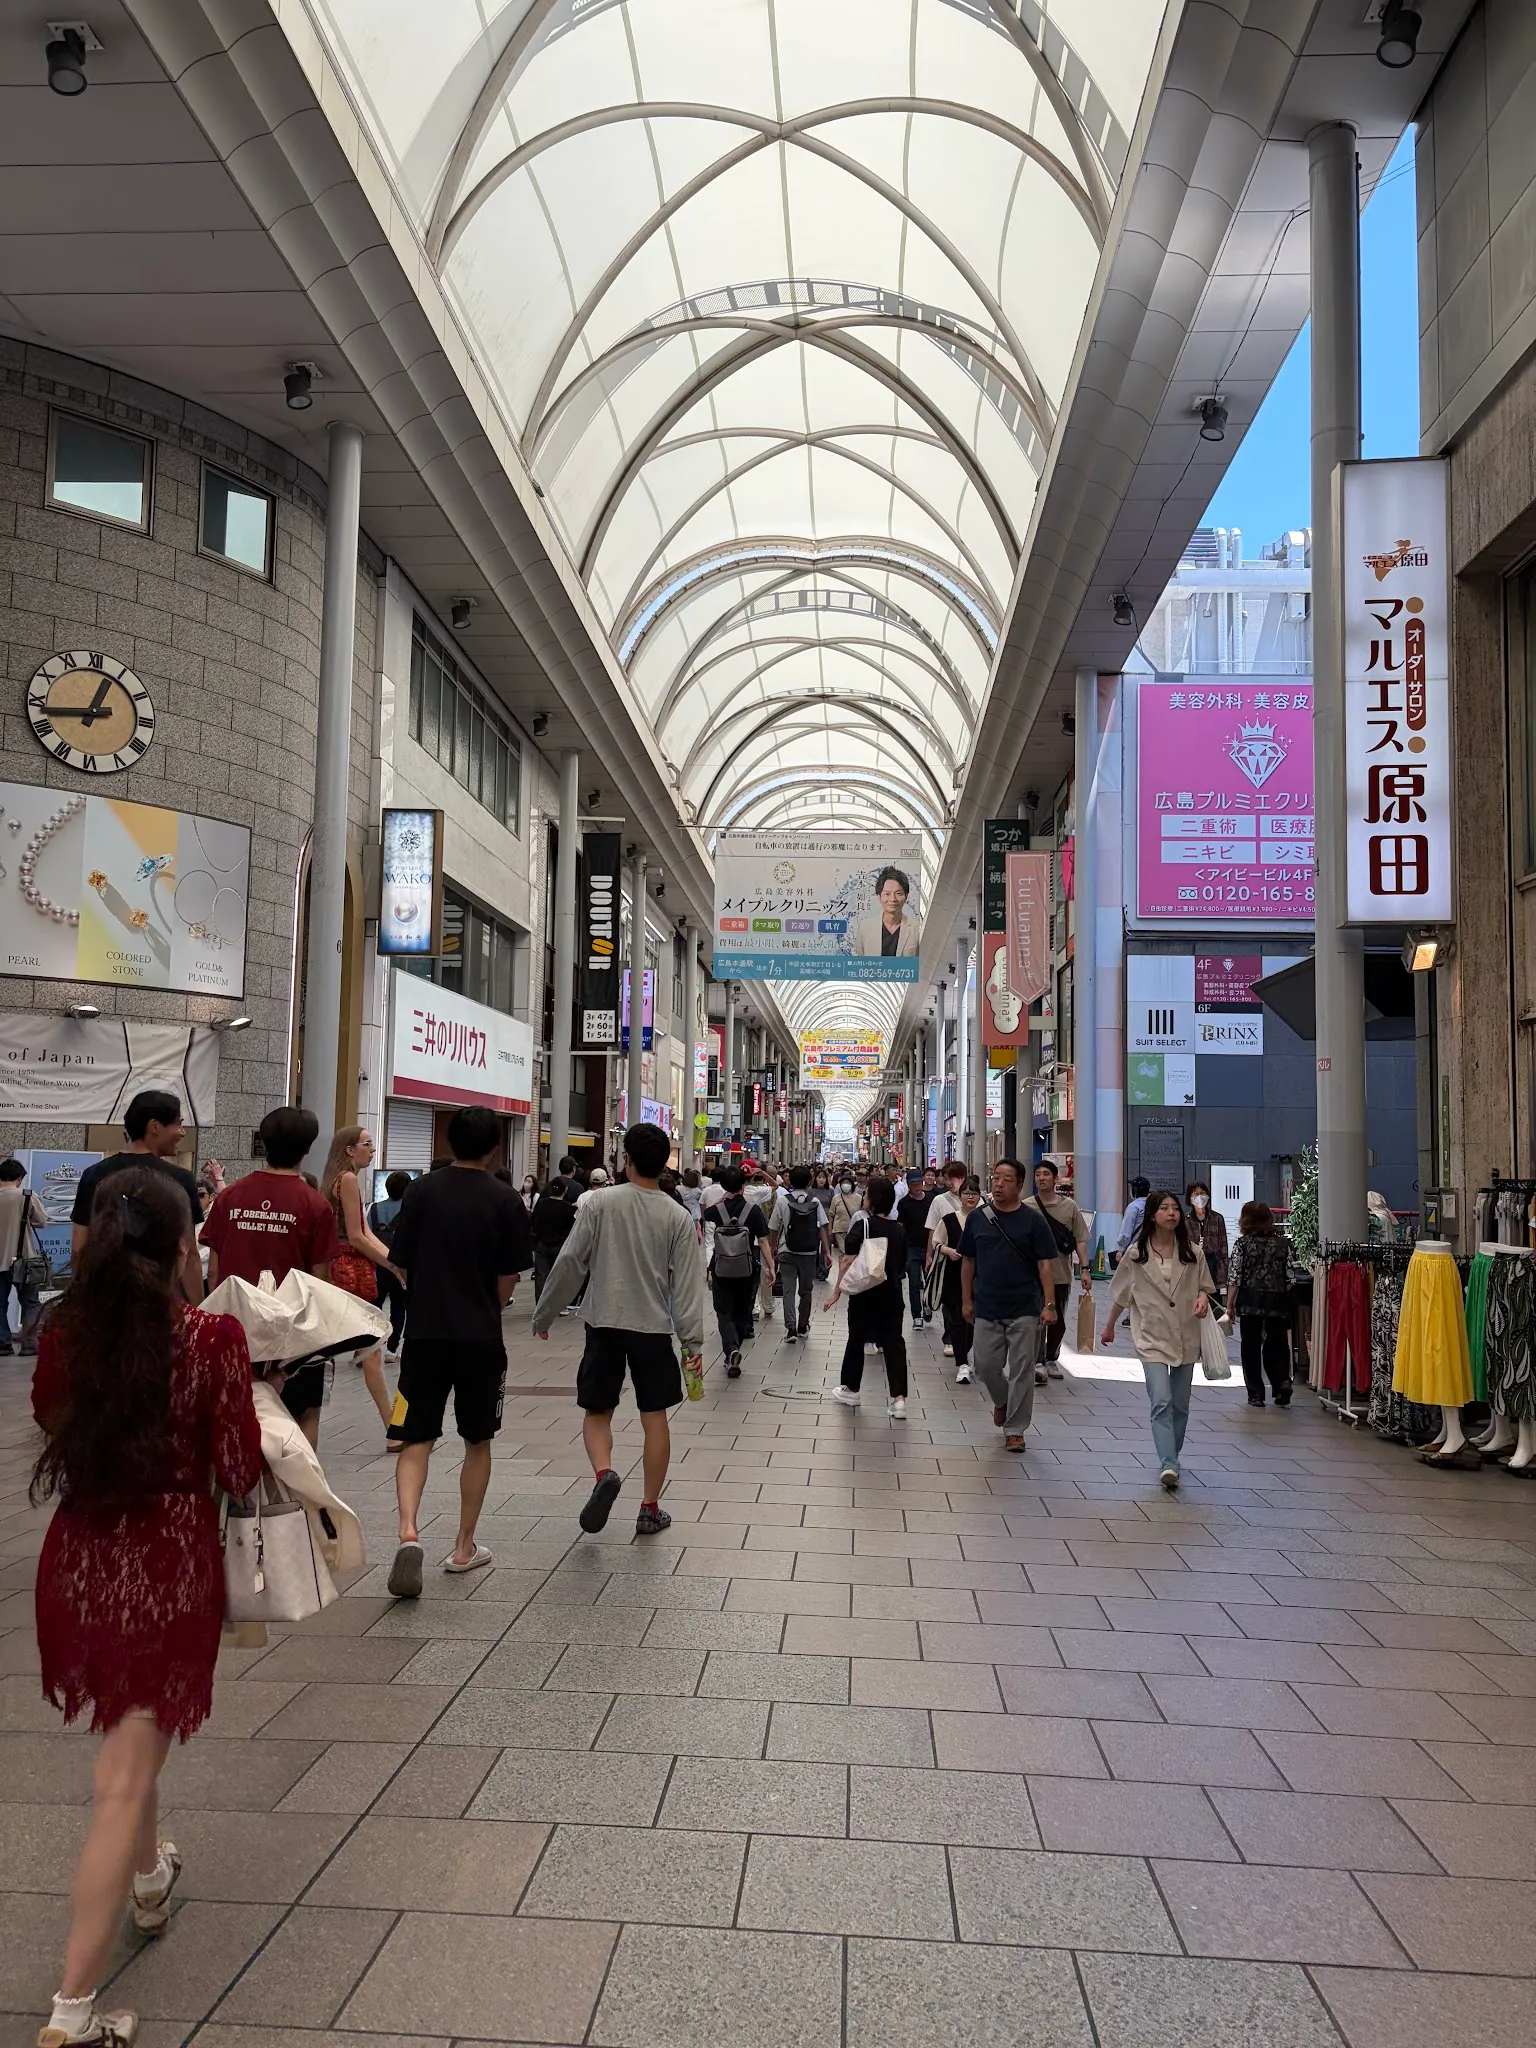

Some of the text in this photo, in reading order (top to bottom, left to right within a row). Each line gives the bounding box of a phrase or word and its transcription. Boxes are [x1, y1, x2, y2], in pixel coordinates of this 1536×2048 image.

[1406, 627, 1423, 722] オーダーサロン
[1169, 692, 1314, 710] 美容外科・美容皮
[1363, 598, 1429, 896] マルエス原田
[1181, 818, 1237, 835] 二重術
[994, 828, 1022, 842] つか
[755, 842, 887, 852] 自転車の放置は通行の邪魔になります。
[1182, 845, 1235, 861] ニキビ
[384, 873, 432, 885] WAKO
[754, 887, 815, 897] 広島美容外科
[1202, 886, 1314, 902] 0120-165-8
[719, 898, 849, 915] メイプルクリニック
[588, 875, 615, 970] DOUTOR
[754, 921, 781, 930] クマ取り
[336, 939, 342, 954] 6
[7, 955, 42, 967] PEARL
[105, 951, 152, 964] COLORED
[1197, 959, 1212, 970] 4F
[112, 965, 144, 977] STONE
[188, 972, 229, 987] PLATINUM
[1197, 1004, 1212, 1013] 6F
[411, 1009, 488, 1071] 三井のリハウス
[1136, 1039, 1154, 1047] SUIT
[804, 1045, 880, 1053] 広島市プレミアム付商品券
[8, 1047, 95, 1067] of Japan
[267, 1222, 289, 1234] BALL
